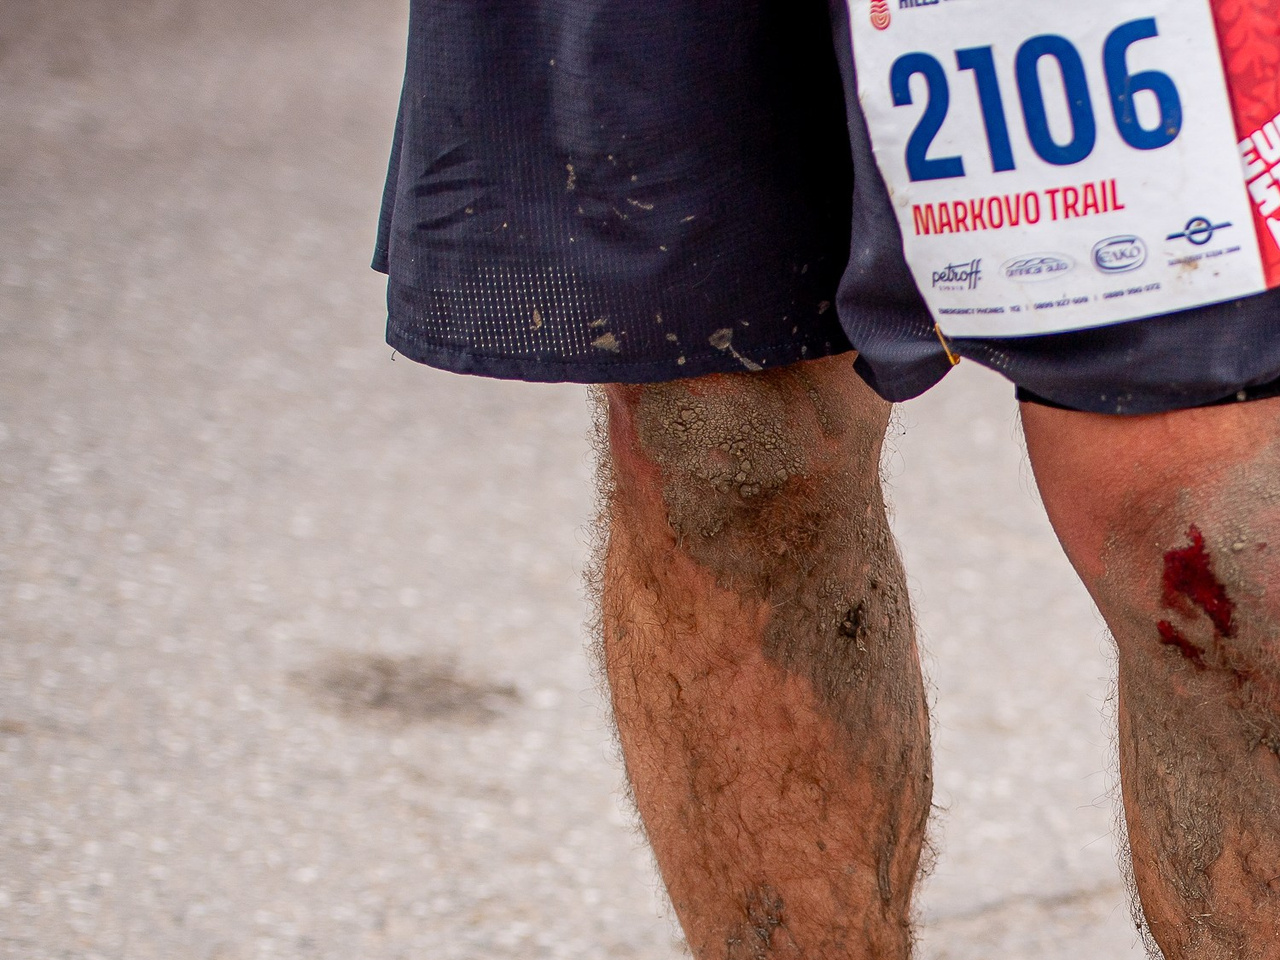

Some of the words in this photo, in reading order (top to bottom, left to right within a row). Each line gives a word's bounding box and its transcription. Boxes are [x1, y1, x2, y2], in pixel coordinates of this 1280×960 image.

[889, 17, 1183, 182] 2106
[912, 190, 1041, 235] MARKOVO
[1044, 178, 1125, 221] TRAIL
